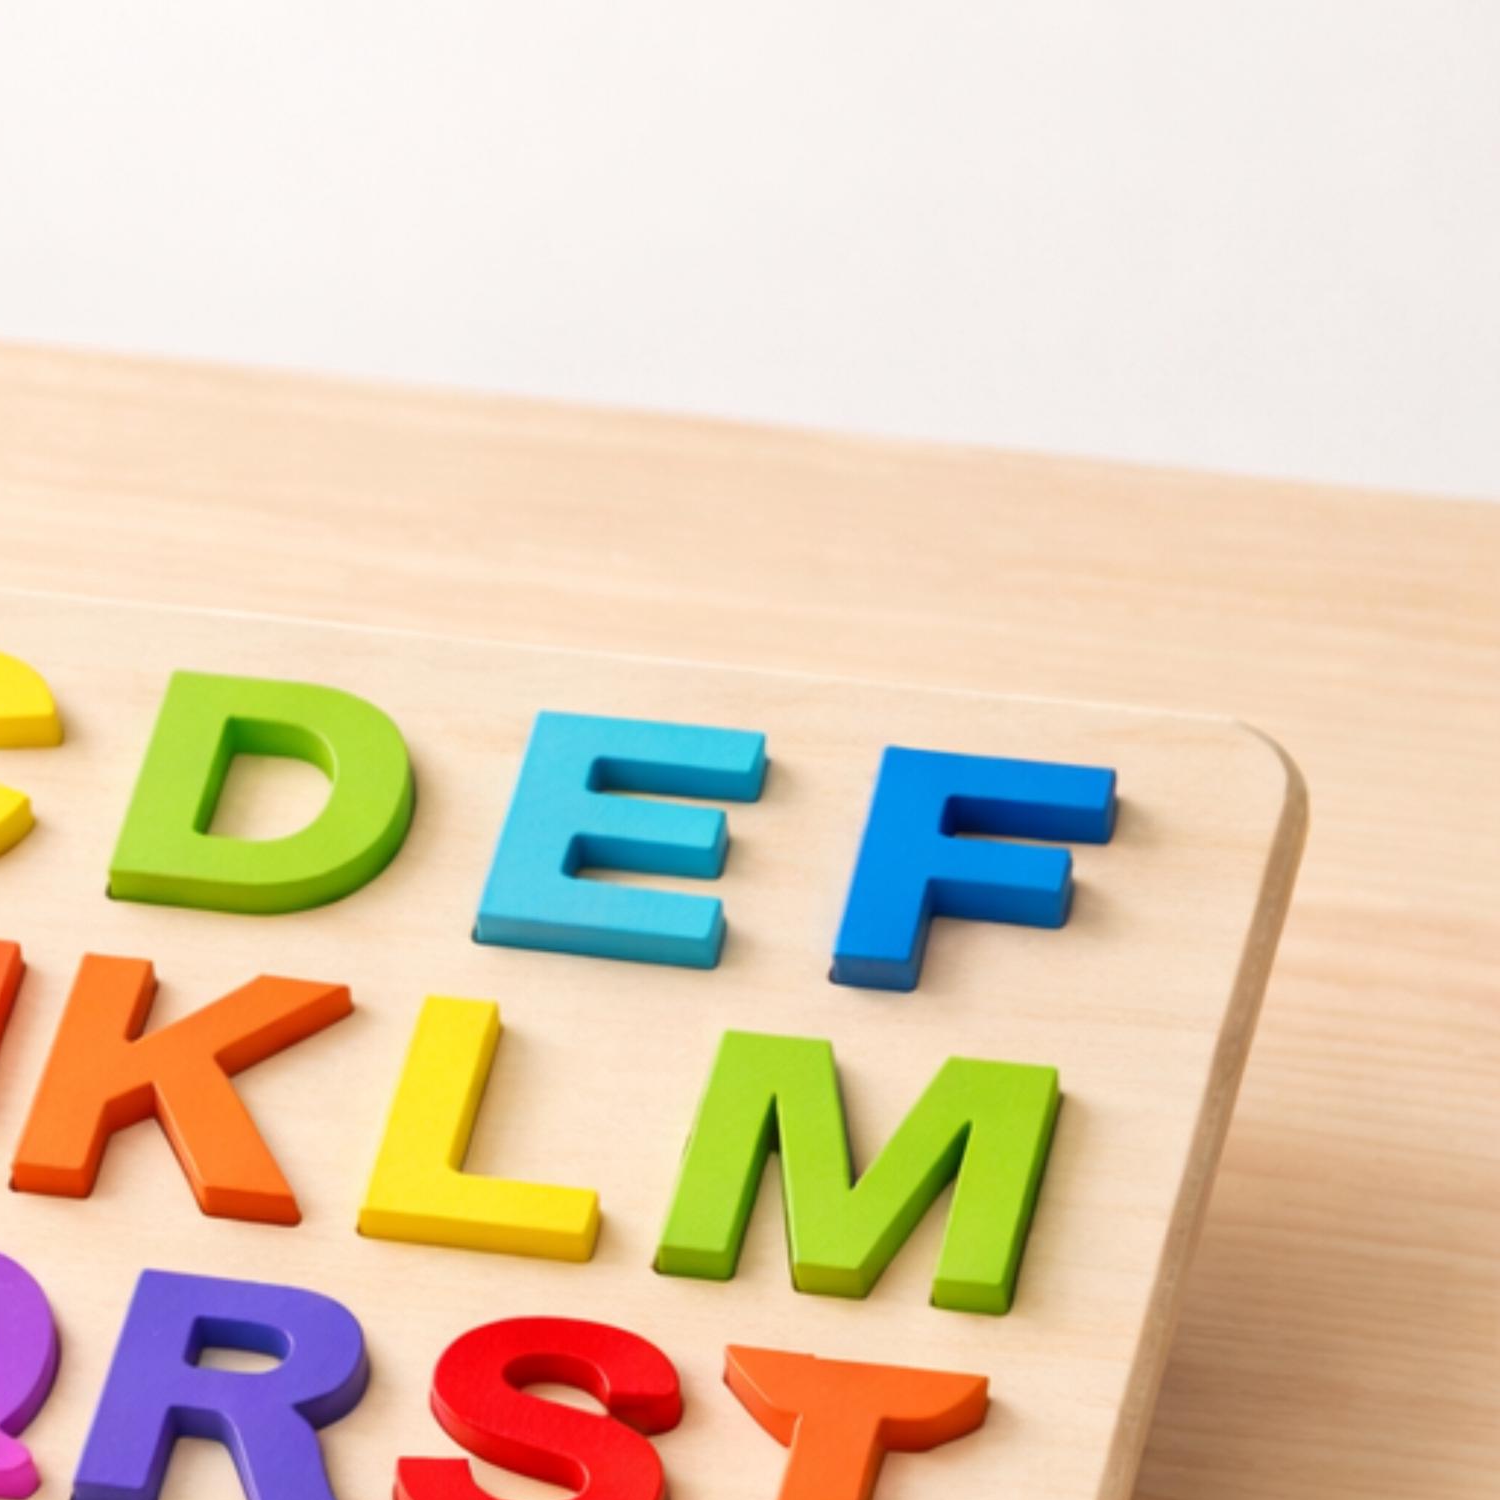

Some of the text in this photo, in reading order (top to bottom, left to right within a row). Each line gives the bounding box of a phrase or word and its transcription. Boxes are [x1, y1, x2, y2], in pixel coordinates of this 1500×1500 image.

[107, 671, 417, 914] D
[474, 711, 768, 968] E
[830, 745, 1118, 991] F
[11, 953, 355, 1226] K
[358, 995, 602, 1264] L
[652, 1031, 1064, 1317] M
